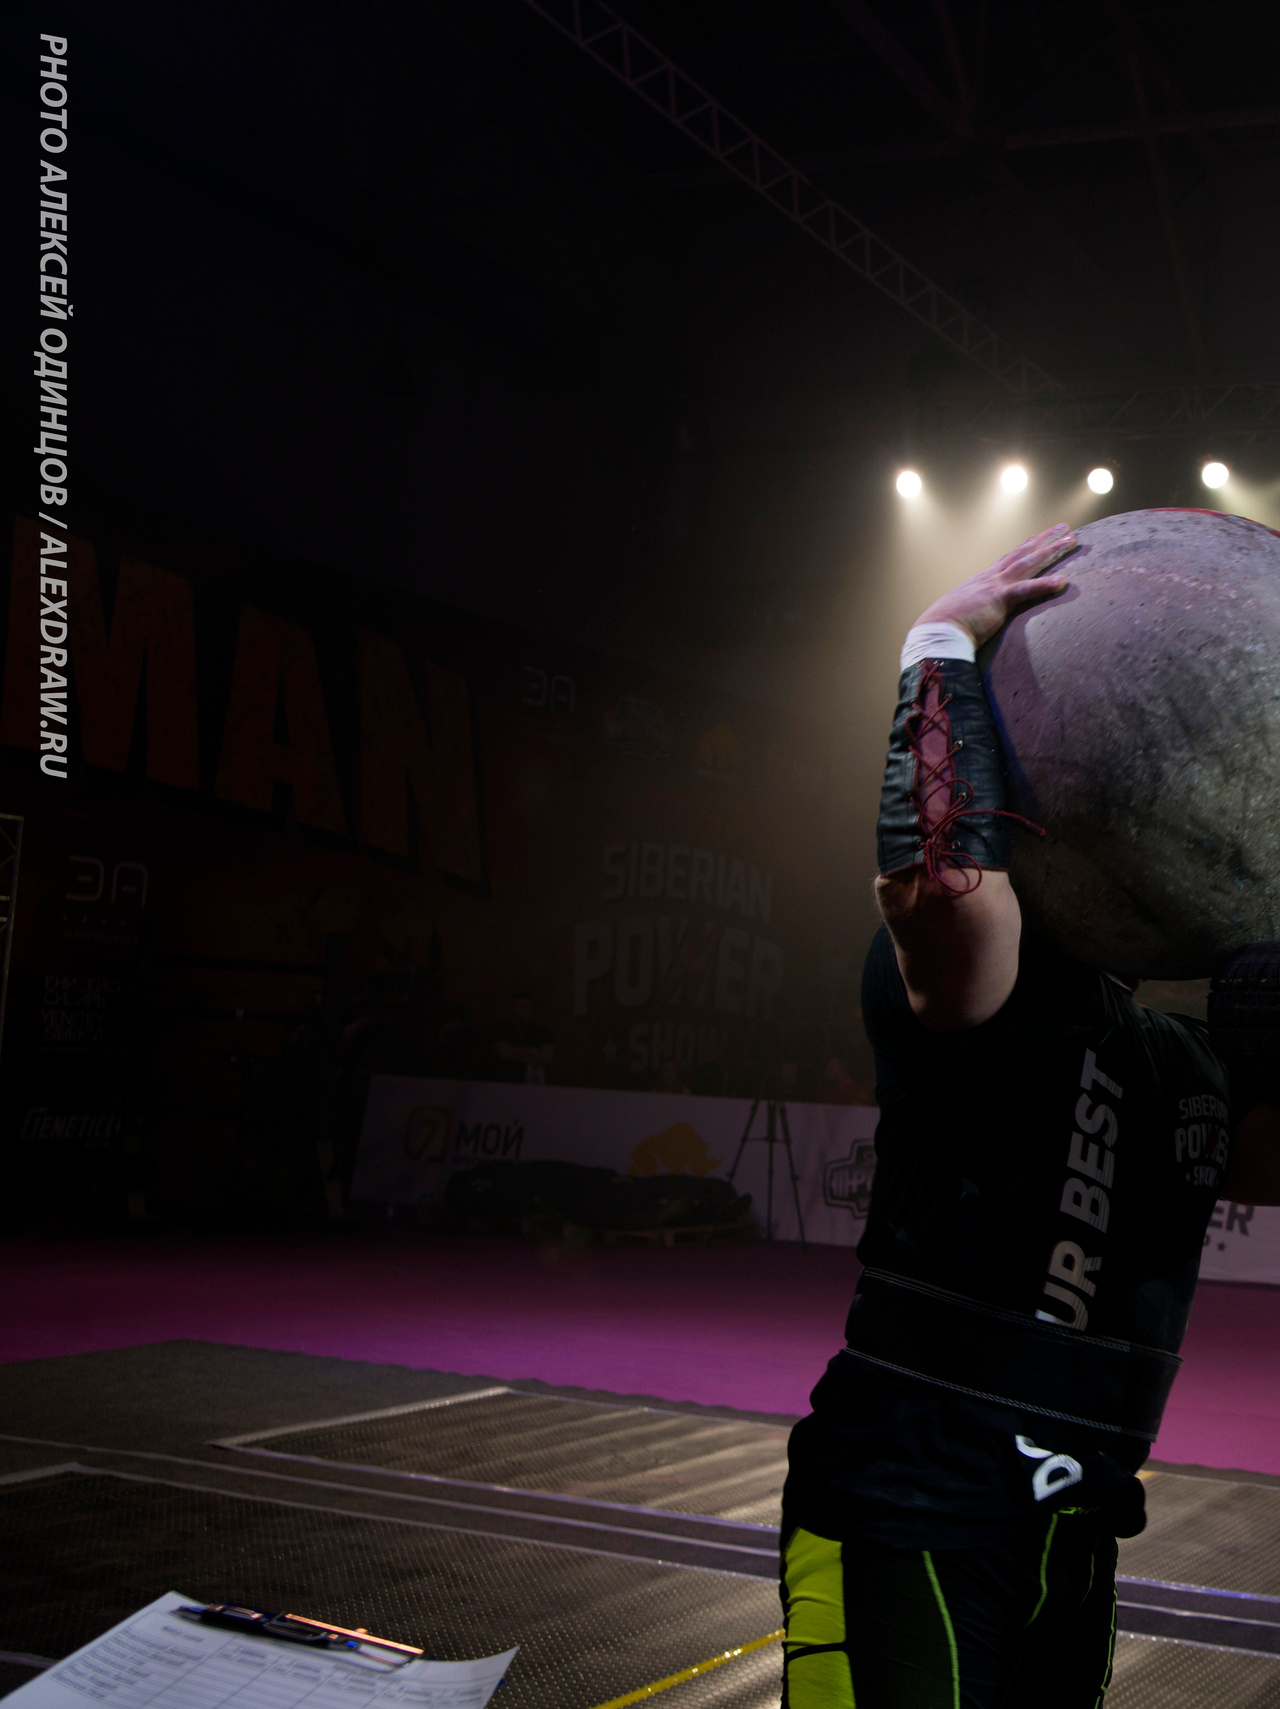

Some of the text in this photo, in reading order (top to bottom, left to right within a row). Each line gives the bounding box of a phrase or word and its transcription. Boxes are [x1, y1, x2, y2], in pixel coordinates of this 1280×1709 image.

[0, 513, 487, 885] MAN
[600, 841, 774, 923] SIBERIAN
[573, 914, 785, 1017] POWER
[455, 1119, 525, 1158] МОЙ
[1058, 1048, 1124, 1235] BEST
